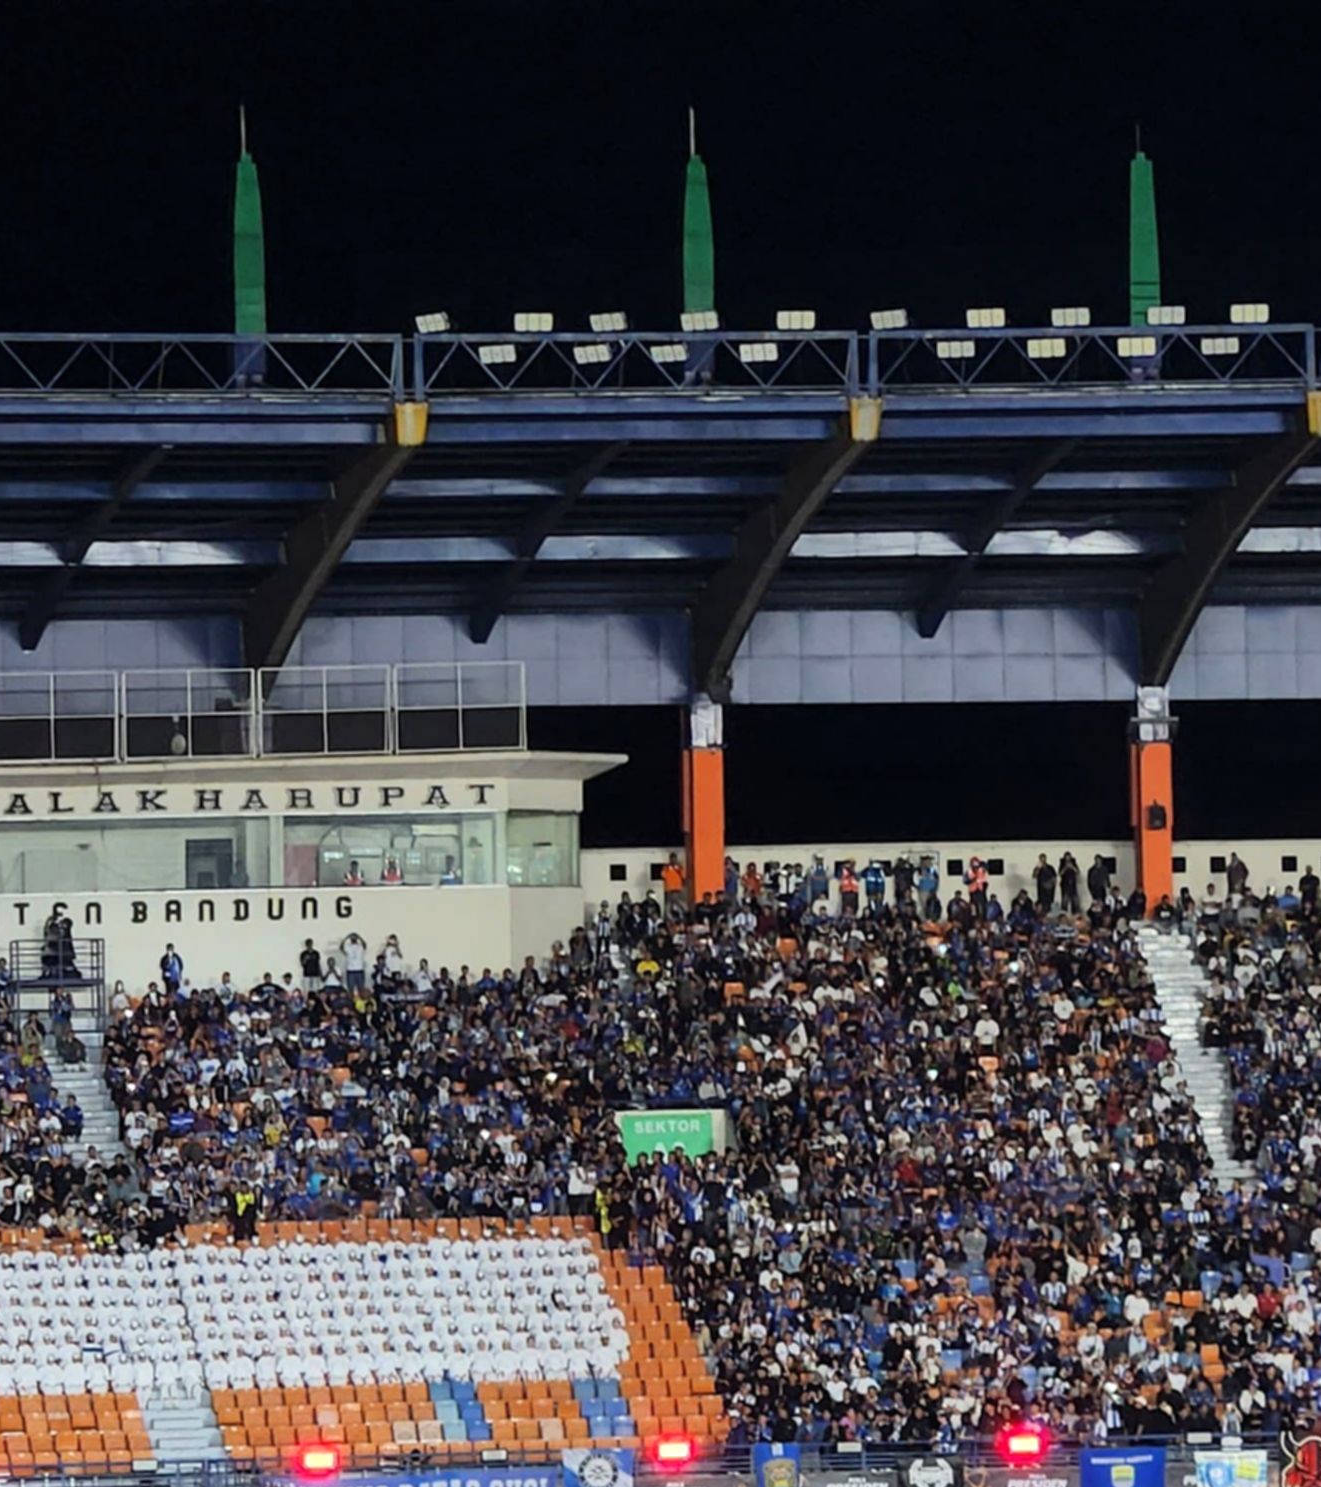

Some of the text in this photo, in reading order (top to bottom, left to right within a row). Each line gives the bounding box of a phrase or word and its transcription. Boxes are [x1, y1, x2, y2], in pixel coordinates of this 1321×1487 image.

[194, 783, 495, 811] HARUPAT
[131, 896, 353, 923] BANDUNG
[634, 1121, 700, 1134] SEKTOR
